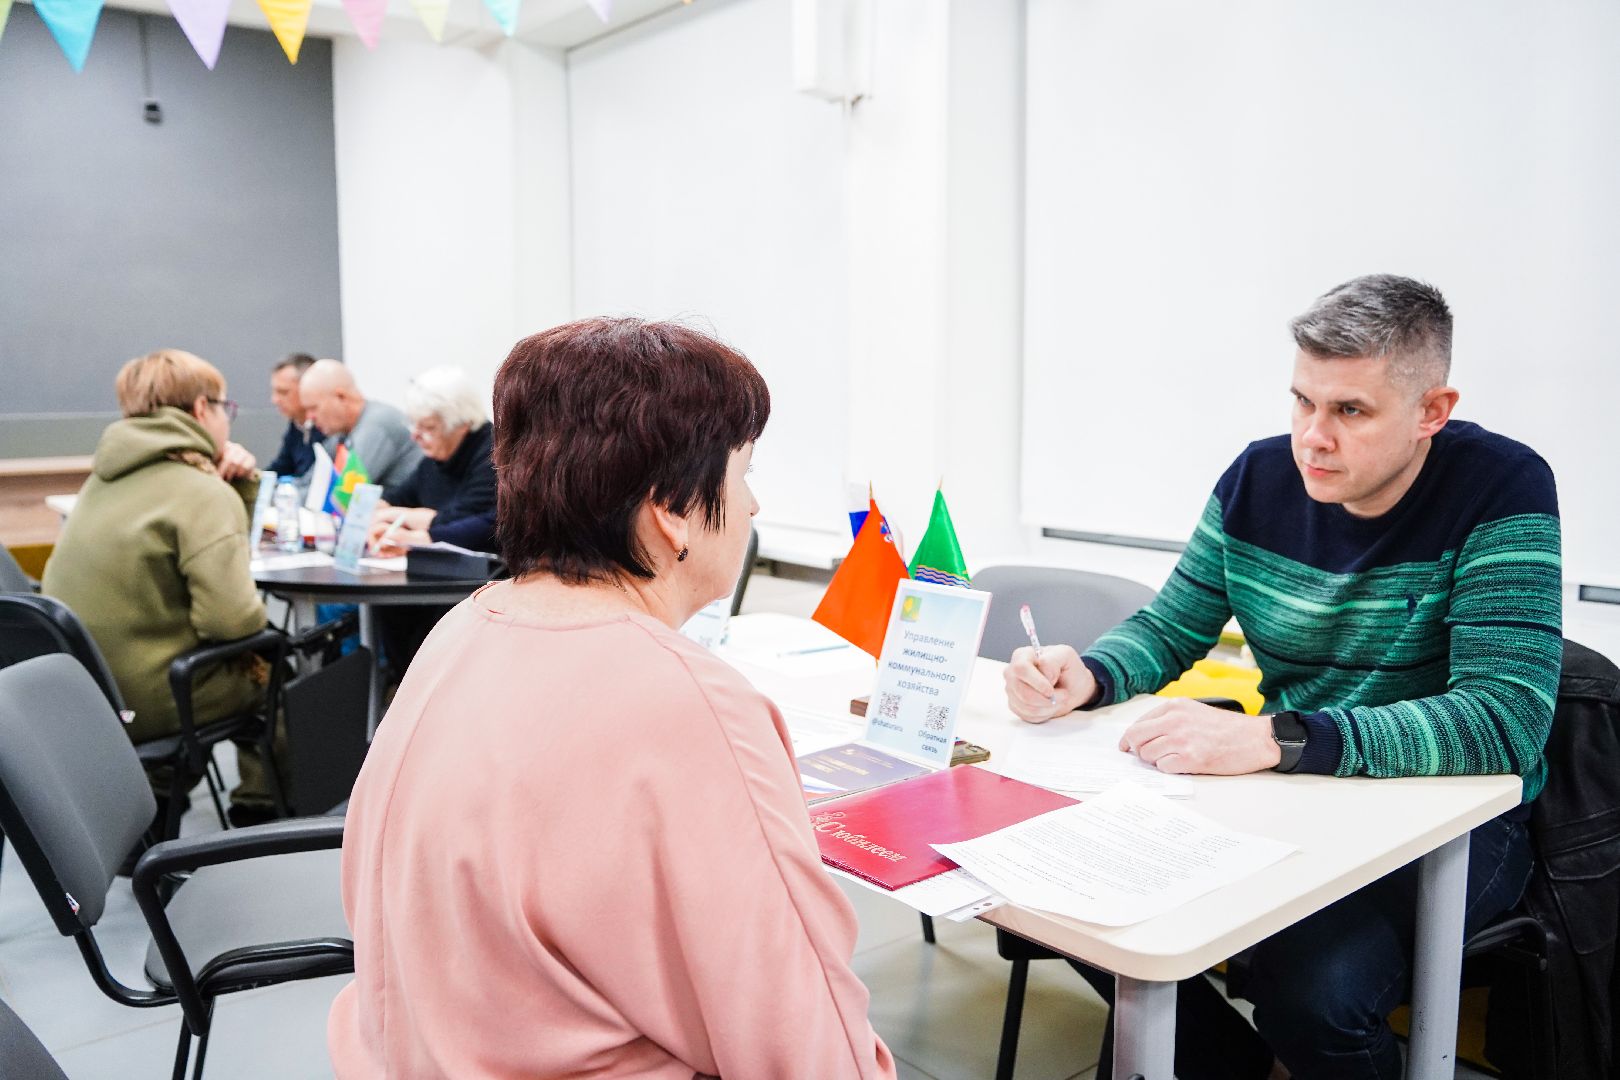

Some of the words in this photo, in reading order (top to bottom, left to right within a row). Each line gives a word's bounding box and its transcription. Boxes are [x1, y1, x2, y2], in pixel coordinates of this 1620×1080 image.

[903, 628, 956, 649] Управление
[902, 647, 948, 664] жилищно-
[887, 661, 956, 683] коммунального
[896, 680, 940, 697] хозяйства
[918, 729, 948, 744] Обратная
[921, 744, 938, 754] связь
[830, 829, 907, 863] юбилеем
